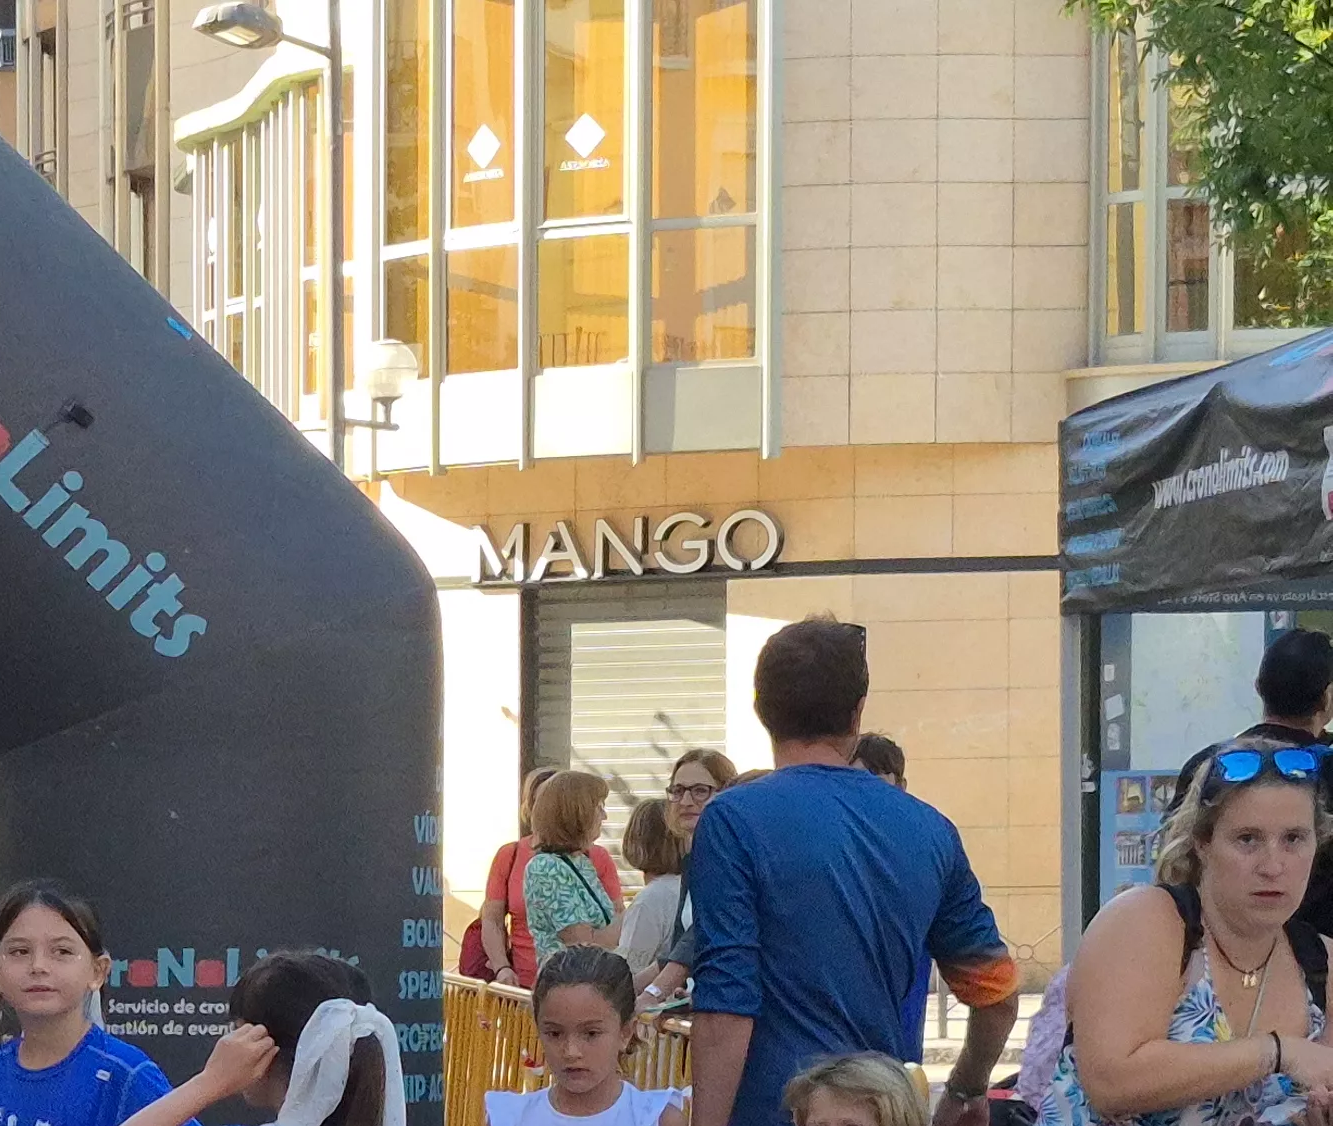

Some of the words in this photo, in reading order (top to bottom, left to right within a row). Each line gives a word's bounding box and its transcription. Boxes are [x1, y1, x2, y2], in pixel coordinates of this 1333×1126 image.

[470, 509, 786, 583] MANGO
[107, 999, 169, 1015] Servicio
[172, 998, 195, 1015] de
[162, 1019, 183, 1035] de
